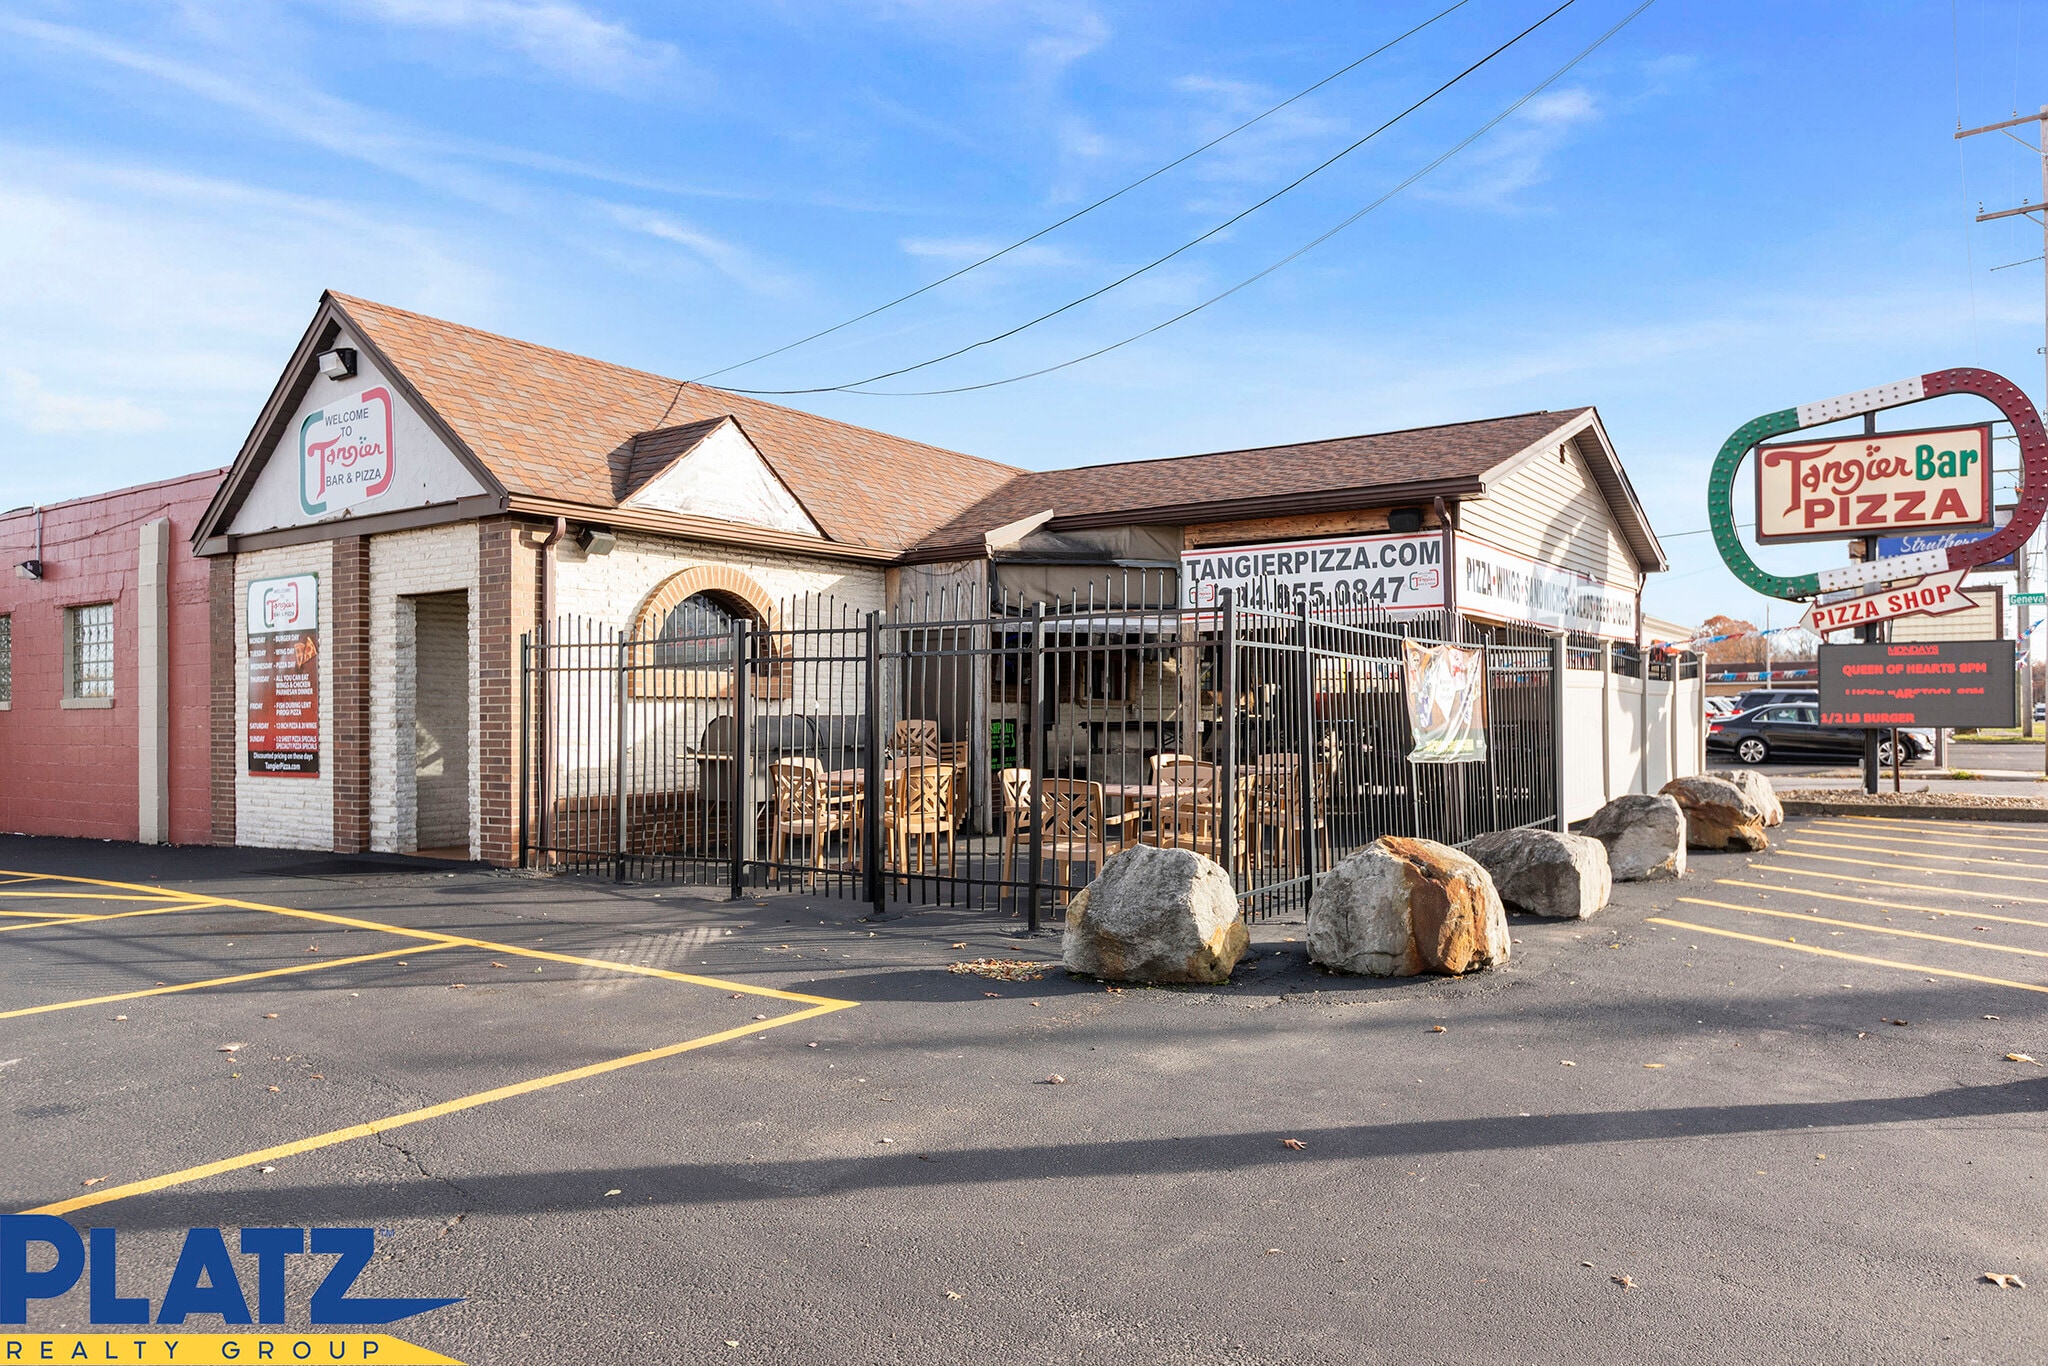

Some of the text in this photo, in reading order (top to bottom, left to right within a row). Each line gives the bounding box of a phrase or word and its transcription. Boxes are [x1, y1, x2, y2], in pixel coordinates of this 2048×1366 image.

[325, 408, 369, 426] WELCOME
[340, 426, 352, 437] TO
[1915, 444, 1978, 480] Bar
[326, 468, 382, 487] BAR & PIZZA
[1804, 488, 1968, 528] PIZZA
[1186, 540, 1440, 581] TANGIERPIZZA.COM
[1466, 556, 1492, 596] PIZZA
[1496, 566, 1520, 604] WINGS
[1525, 576, 1569, 615] SANDWICHES
[1811, 584, 1952, 629] PIZZA SHOP
[2010, 594, 2044, 604] Geneva
[1842, 662, 1987, 677] QUEEN OF HEARTS 8PM
[1821, 713, 1915, 724] 1/2 LB BURGER
